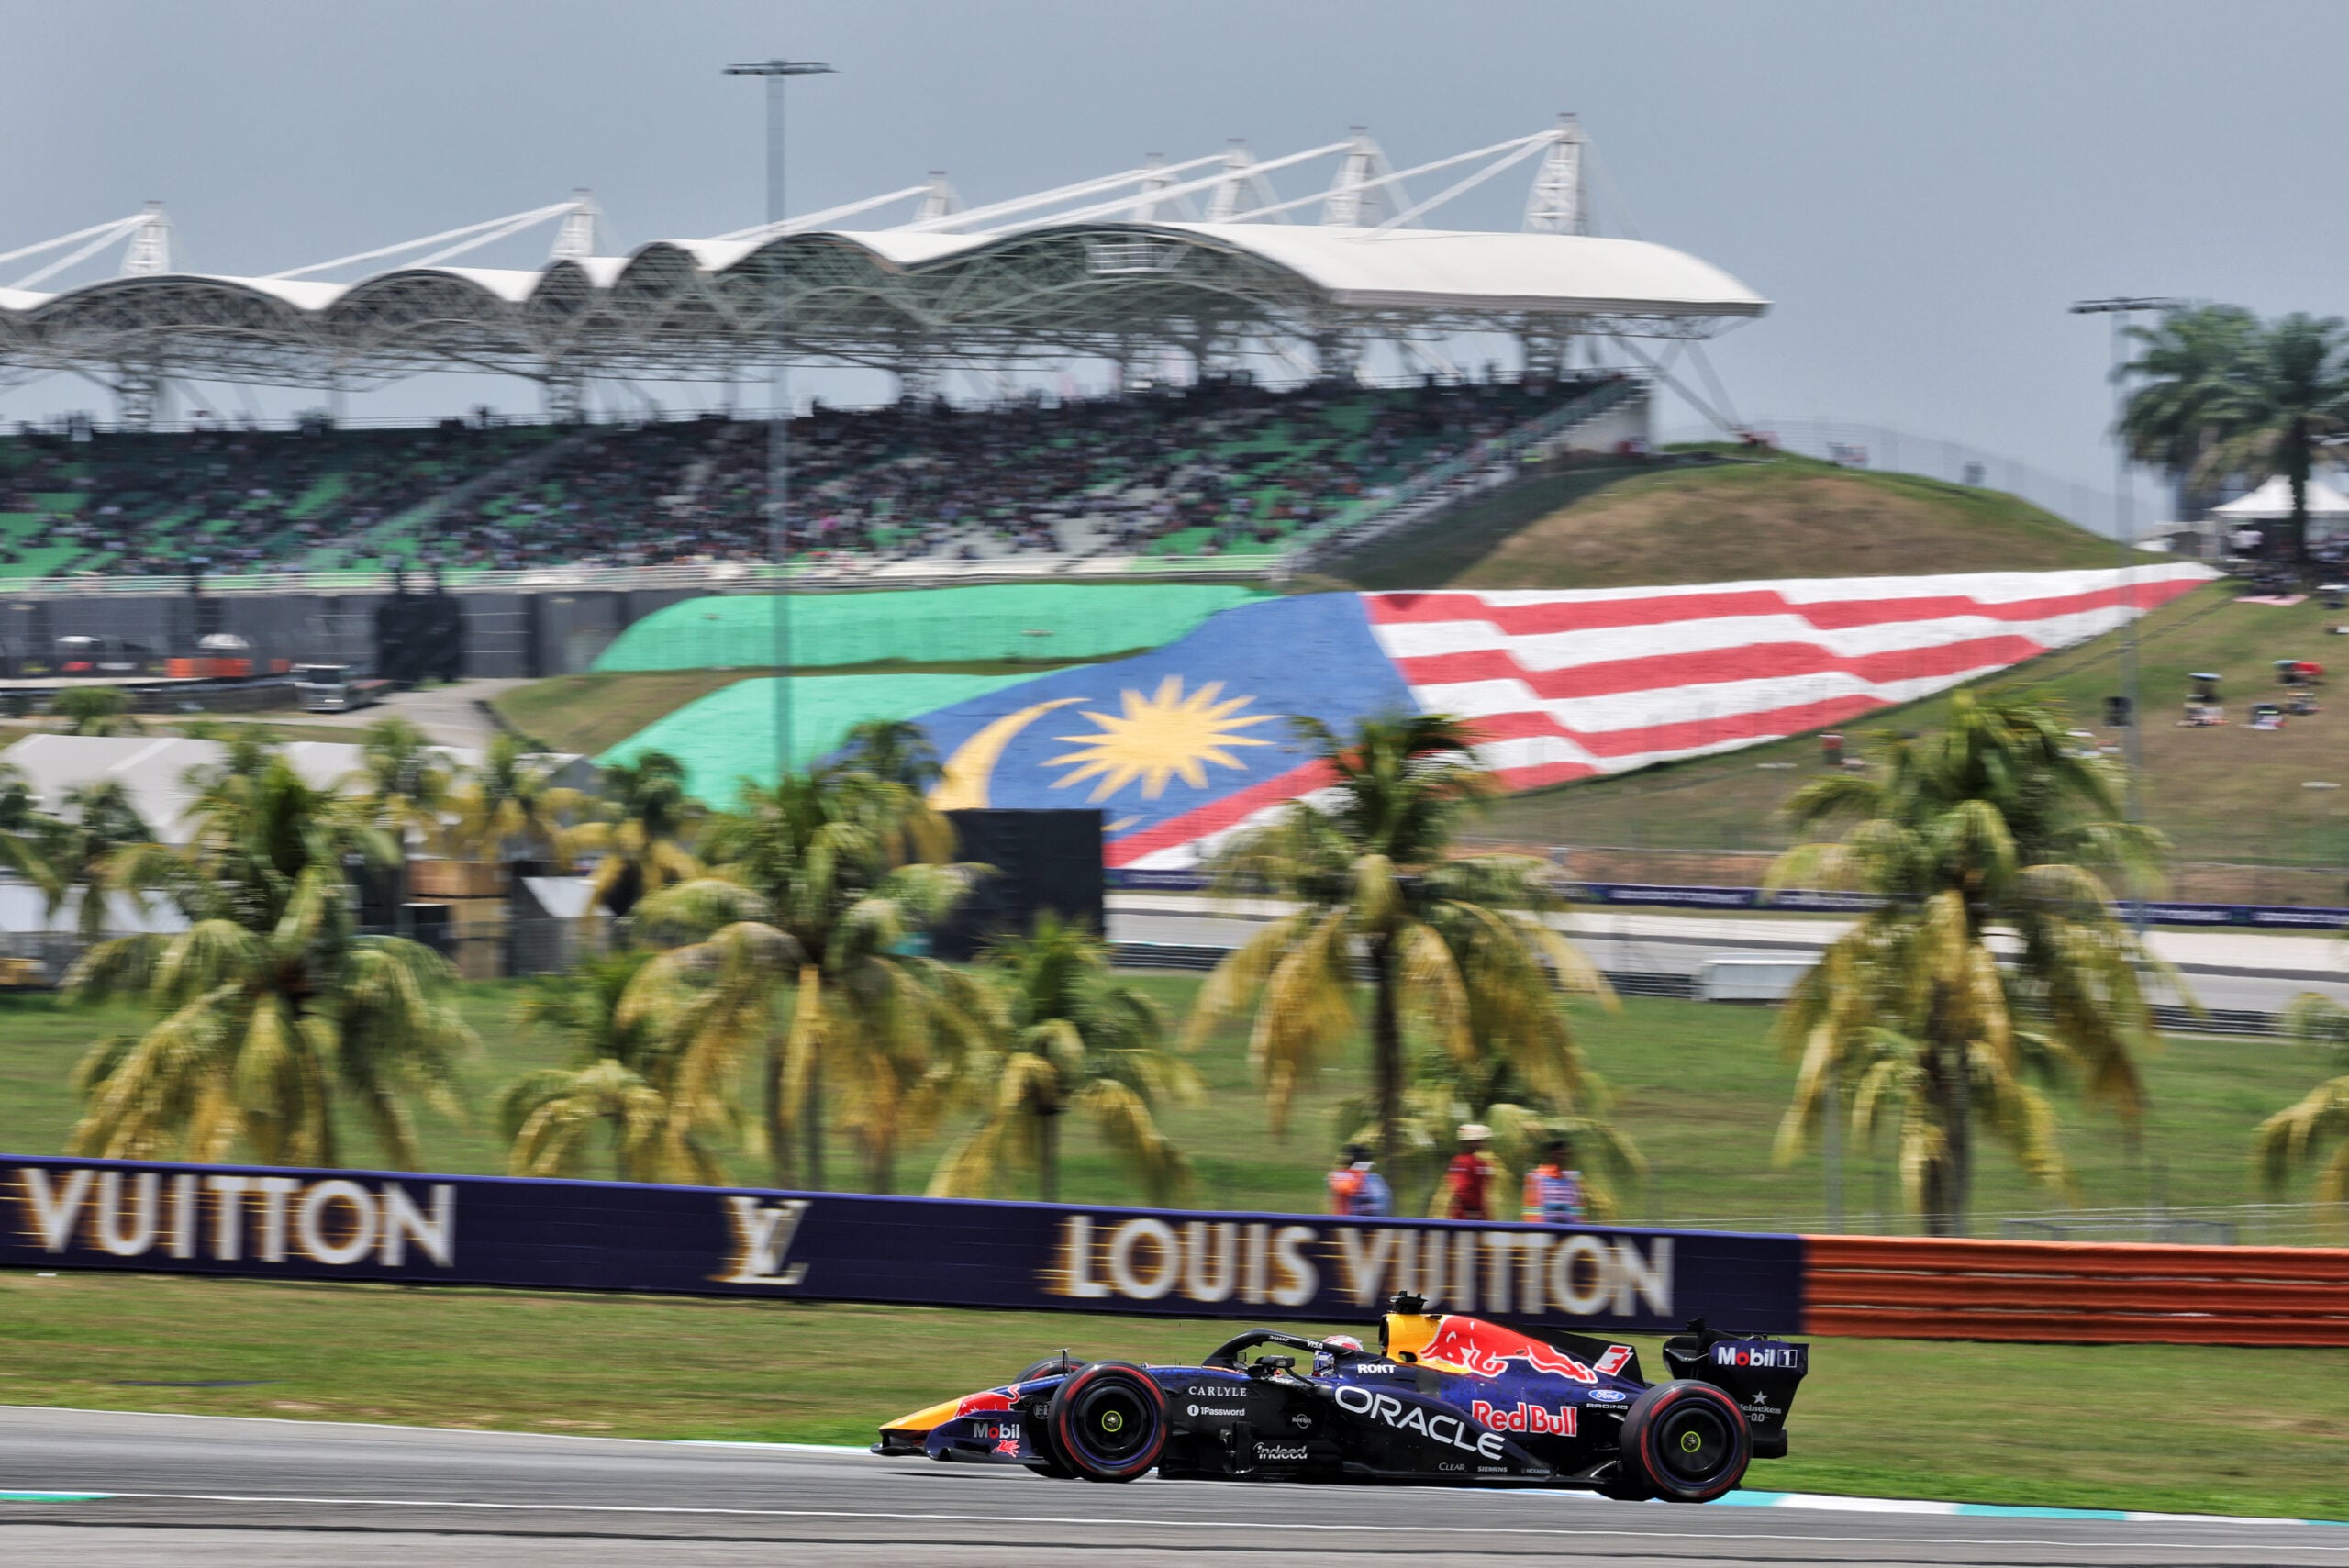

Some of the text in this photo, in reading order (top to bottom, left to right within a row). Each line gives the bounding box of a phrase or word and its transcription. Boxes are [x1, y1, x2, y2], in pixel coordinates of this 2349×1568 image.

[17, 1167, 456, 1268] VUITTON
[1059, 1215, 1674, 1318] LOUIS VUITTON
[1307, 1340, 1323, 1350] VISA
[1718, 1347, 1790, 1367] Mobil 1
[1357, 1364, 1396, 1374] ROKT
[1188, 1386, 1247, 1396] CARLYLE
[1200, 1407, 1245, 1416] 1Password
[1472, 1400, 1577, 1437] Red Bull
[974, 1423, 1020, 1439] Mobil
[1335, 1385, 1506, 1461] ORACLE
[1254, 1442, 1308, 1460] indeed
